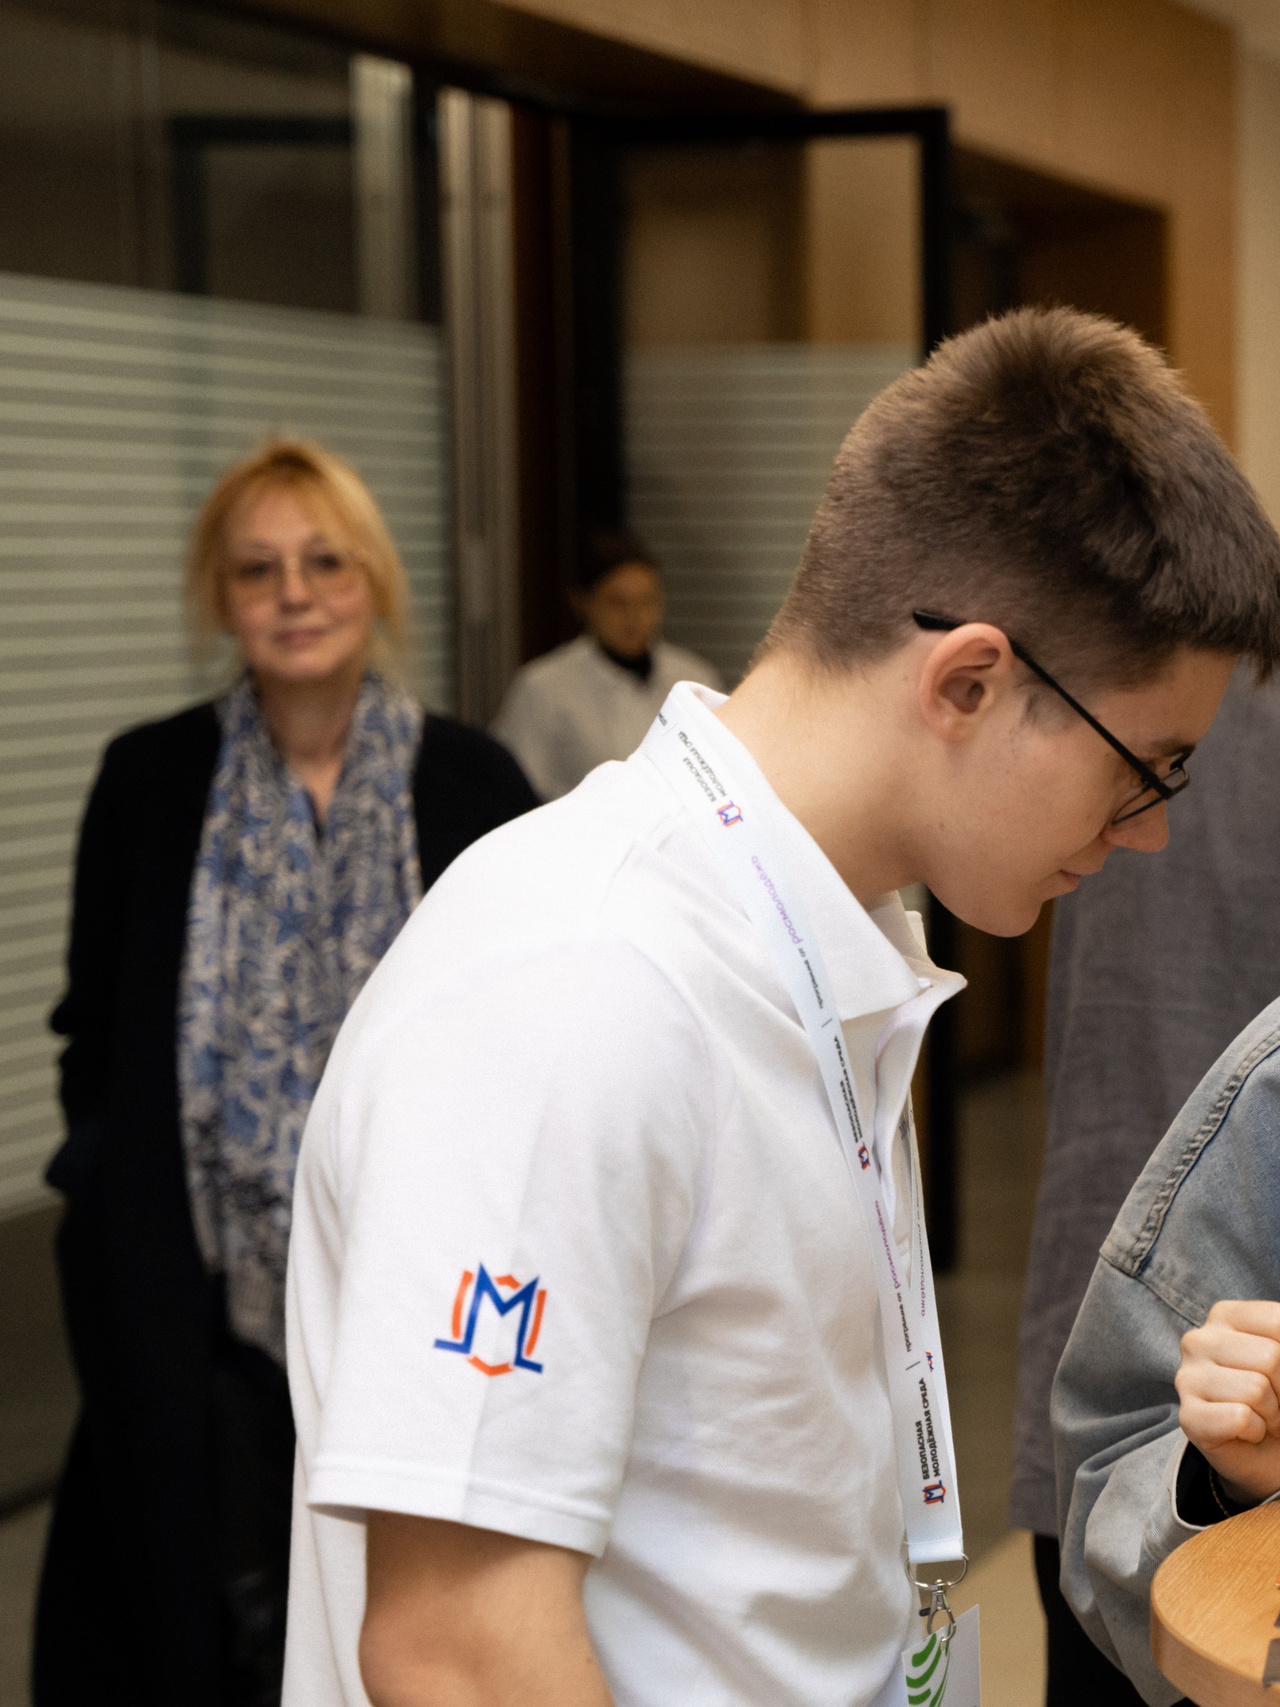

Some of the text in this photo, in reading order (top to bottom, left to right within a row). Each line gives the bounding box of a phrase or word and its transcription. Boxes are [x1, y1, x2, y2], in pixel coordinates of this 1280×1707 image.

[682, 756, 718, 803] БЕЗОПАСНАЯ
[689, 748, 728, 798] МОЛОДЁЖНАЯ
[840, 1080, 859, 1143] БЕЗОПАСНАЯ
[915, 1421, 930, 1480] БЕЗОПАСНАЯ
[918, 1377, 940, 1477] МОЛОДЁЖНАЯ СРЕДА
